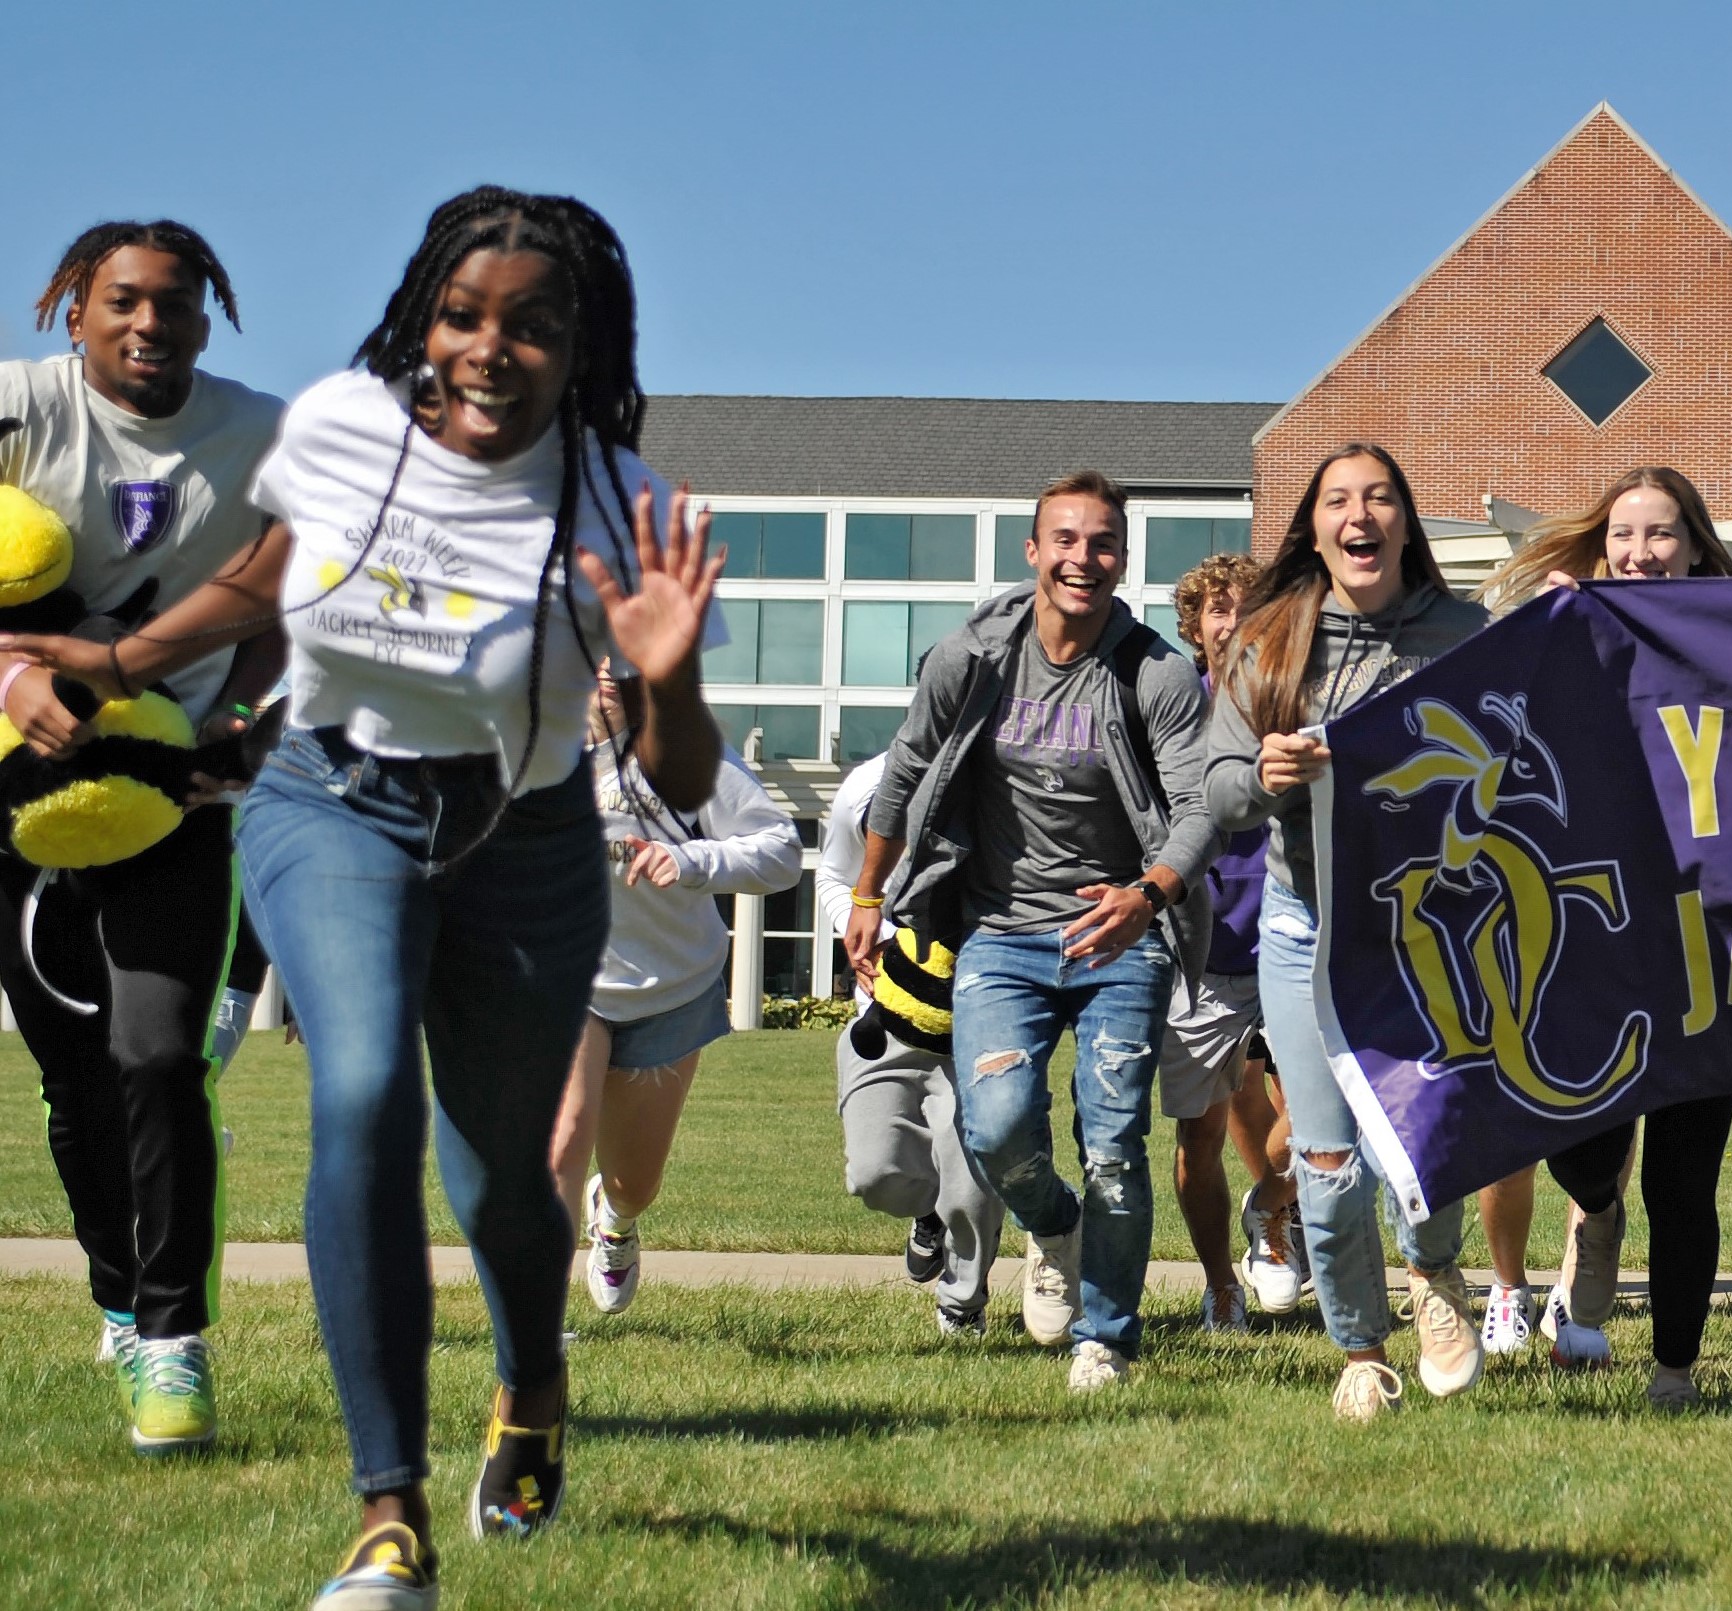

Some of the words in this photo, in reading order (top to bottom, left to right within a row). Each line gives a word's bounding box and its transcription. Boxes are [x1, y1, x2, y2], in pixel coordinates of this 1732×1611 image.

[423, 529, 471, 577] WEEK
[307, 608, 373, 640] JACKET
[386, 629, 474, 660] JOURNEY
